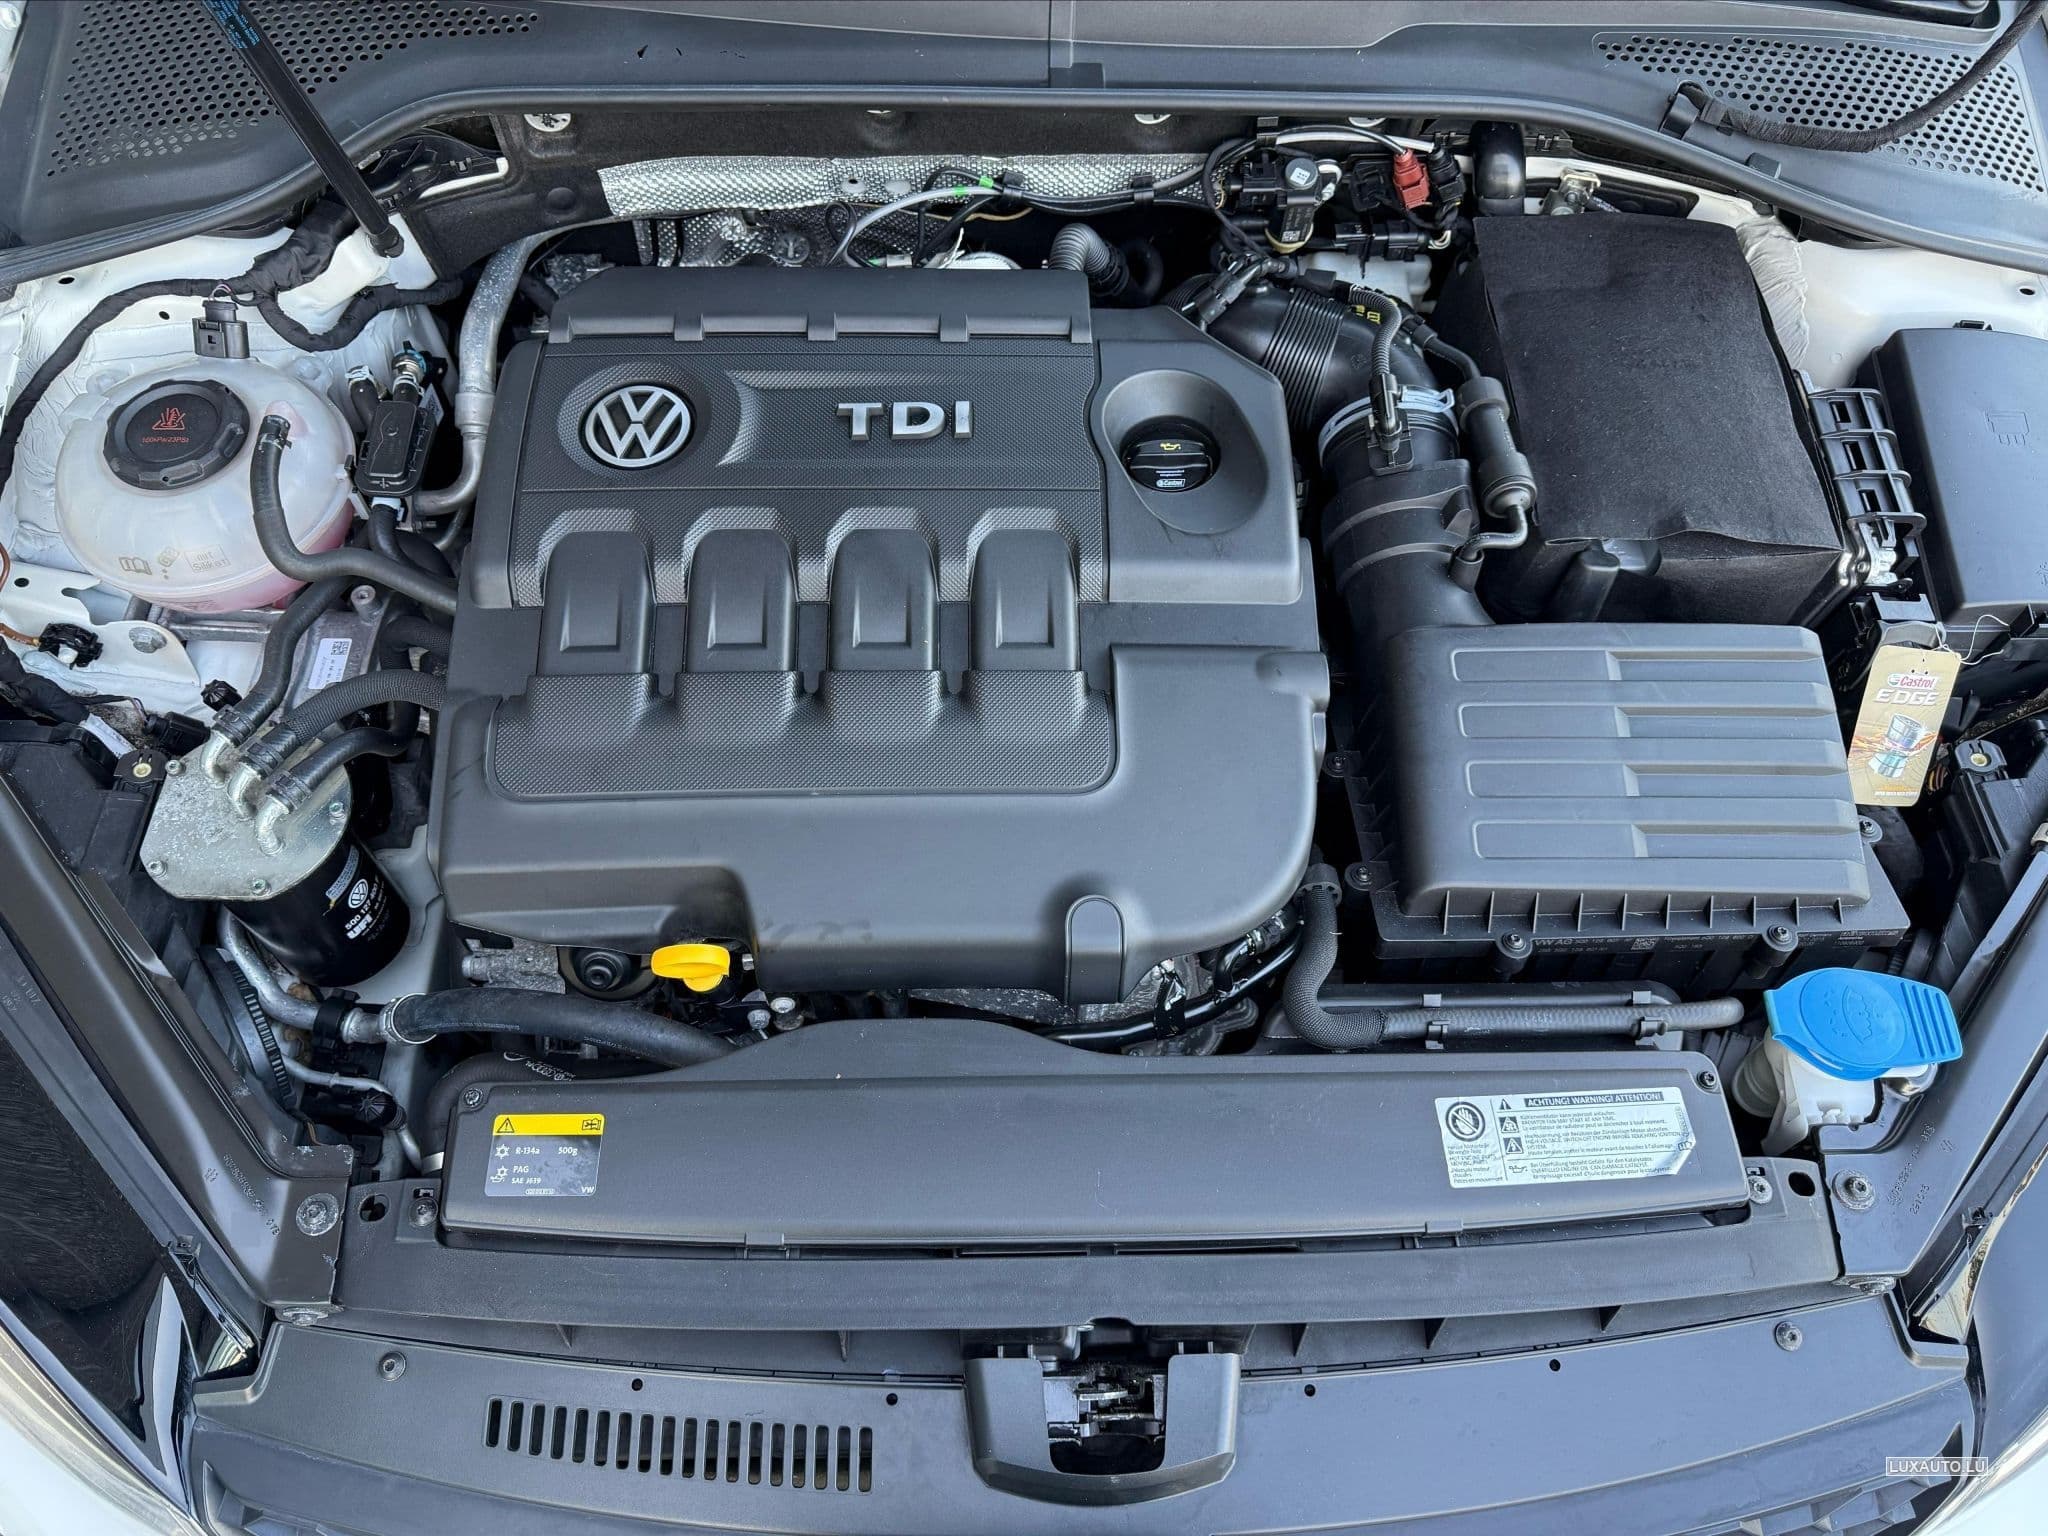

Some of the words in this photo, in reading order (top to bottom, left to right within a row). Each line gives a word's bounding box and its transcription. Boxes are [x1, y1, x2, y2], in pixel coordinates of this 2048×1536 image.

[837, 400, 972, 440] TDI
[1899, 675, 1935, 689] Castrol
[1873, 689, 1939, 706] EDGE
[1526, 1097, 1570, 1106] ACHTUNG!
[1570, 1095, 1614, 1104] WARNING!
[1614, 1093, 1662, 1102] ATTENTION!
[558, 1146, 578, 1156] 500g
[513, 1165, 530, 1173] PAG
[580, 1186, 595, 1194] VW
